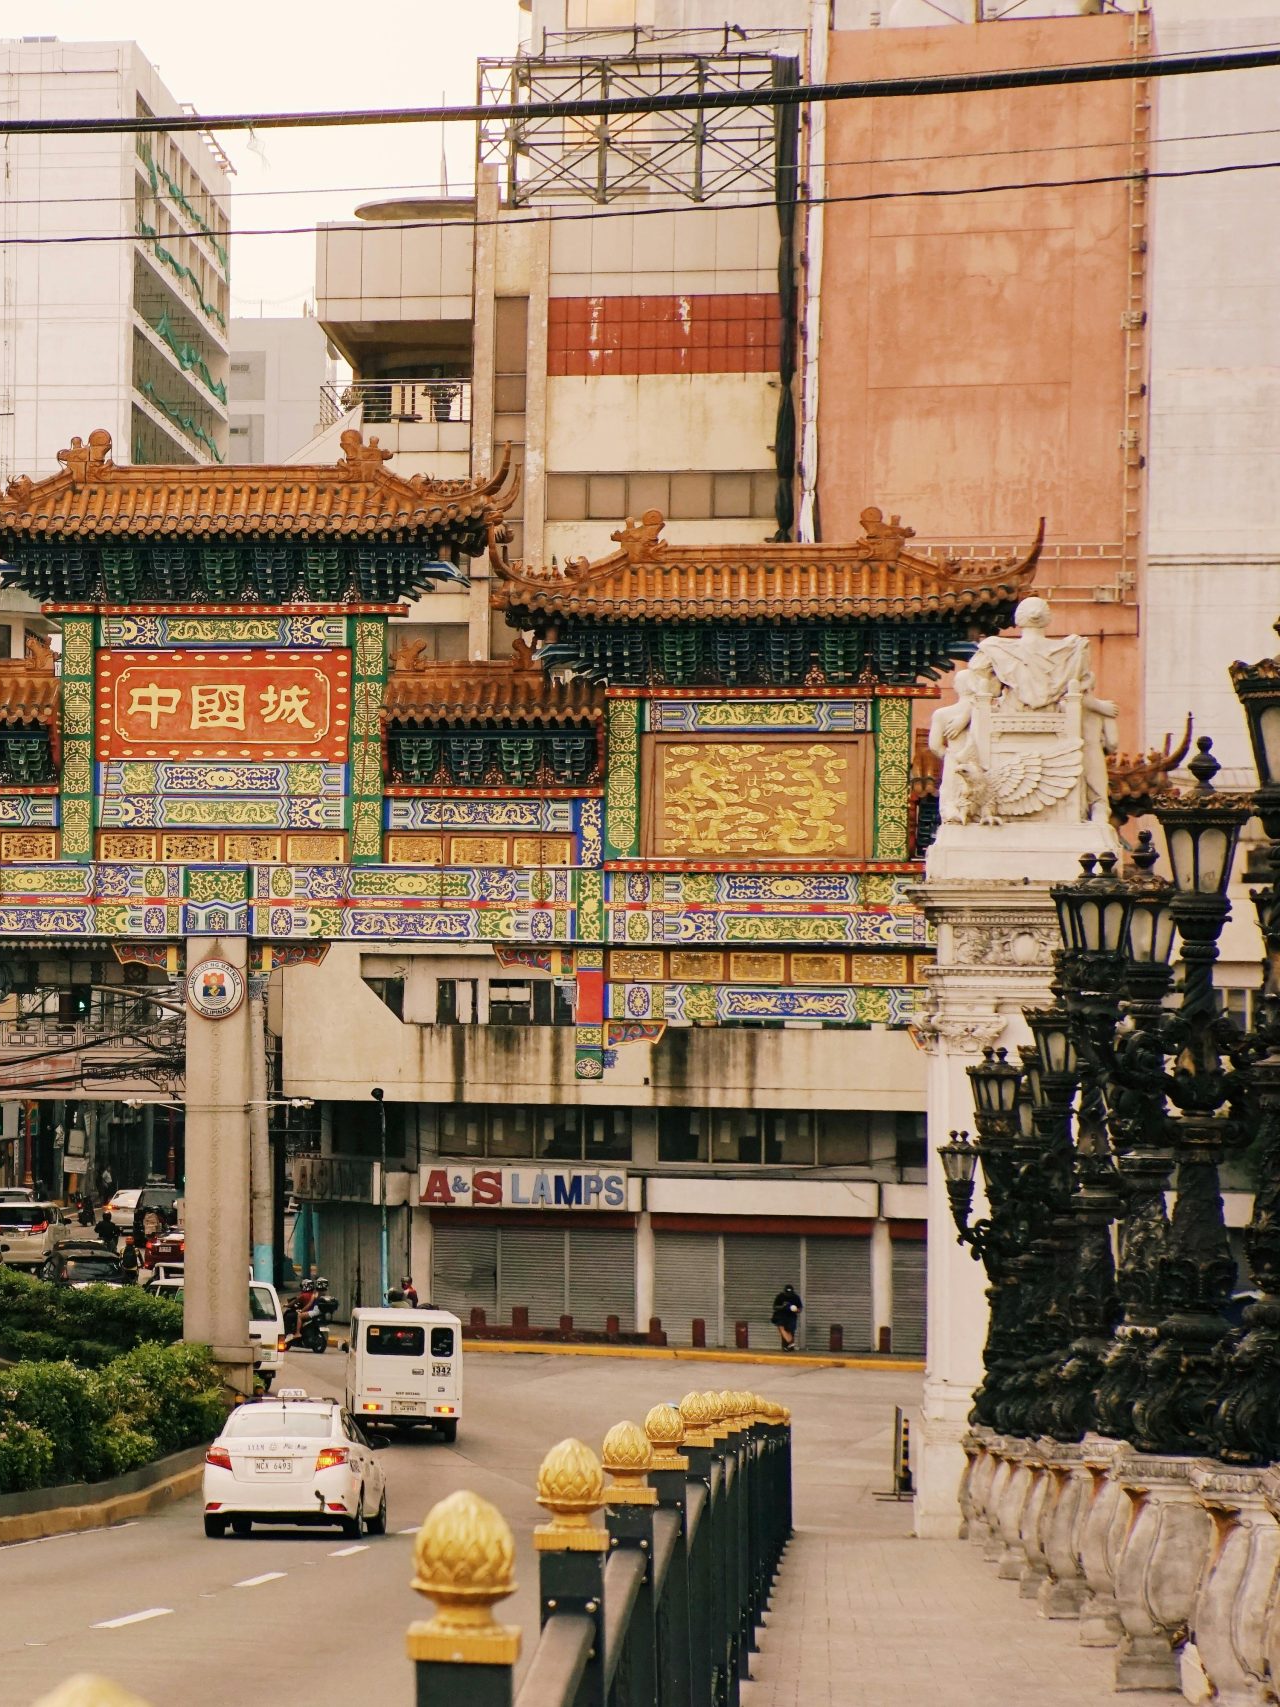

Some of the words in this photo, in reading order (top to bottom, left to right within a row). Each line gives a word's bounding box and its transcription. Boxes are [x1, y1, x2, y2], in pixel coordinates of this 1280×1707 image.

[127, 683, 316, 730] 中國城
[221, 963, 241, 986] MAYNILA
[200, 1006, 231, 1015] PILIPINAS
[419, 1169, 503, 1204] A&S
[511, 1173, 625, 1205] LAMPS
[432, 1366, 451, 1374] 1342
[273, 1462, 291, 1470] 6493
